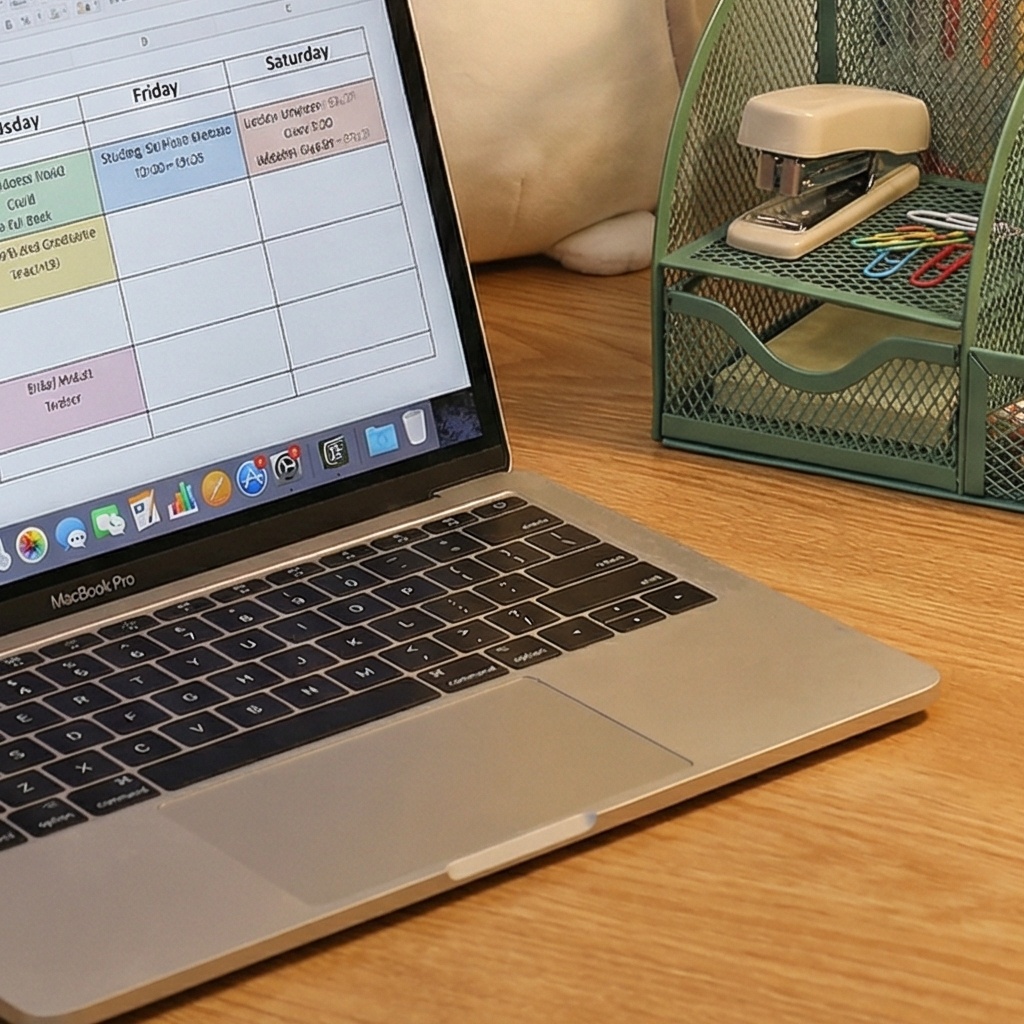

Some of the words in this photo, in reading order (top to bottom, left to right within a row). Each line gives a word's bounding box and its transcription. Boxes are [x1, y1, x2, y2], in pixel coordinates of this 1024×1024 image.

[265, 44, 329, 71] Saturday
[133, 81, 178, 103] Friday
[50, 579, 112, 610] MacBook
[113, 573, 136, 591] Pro
